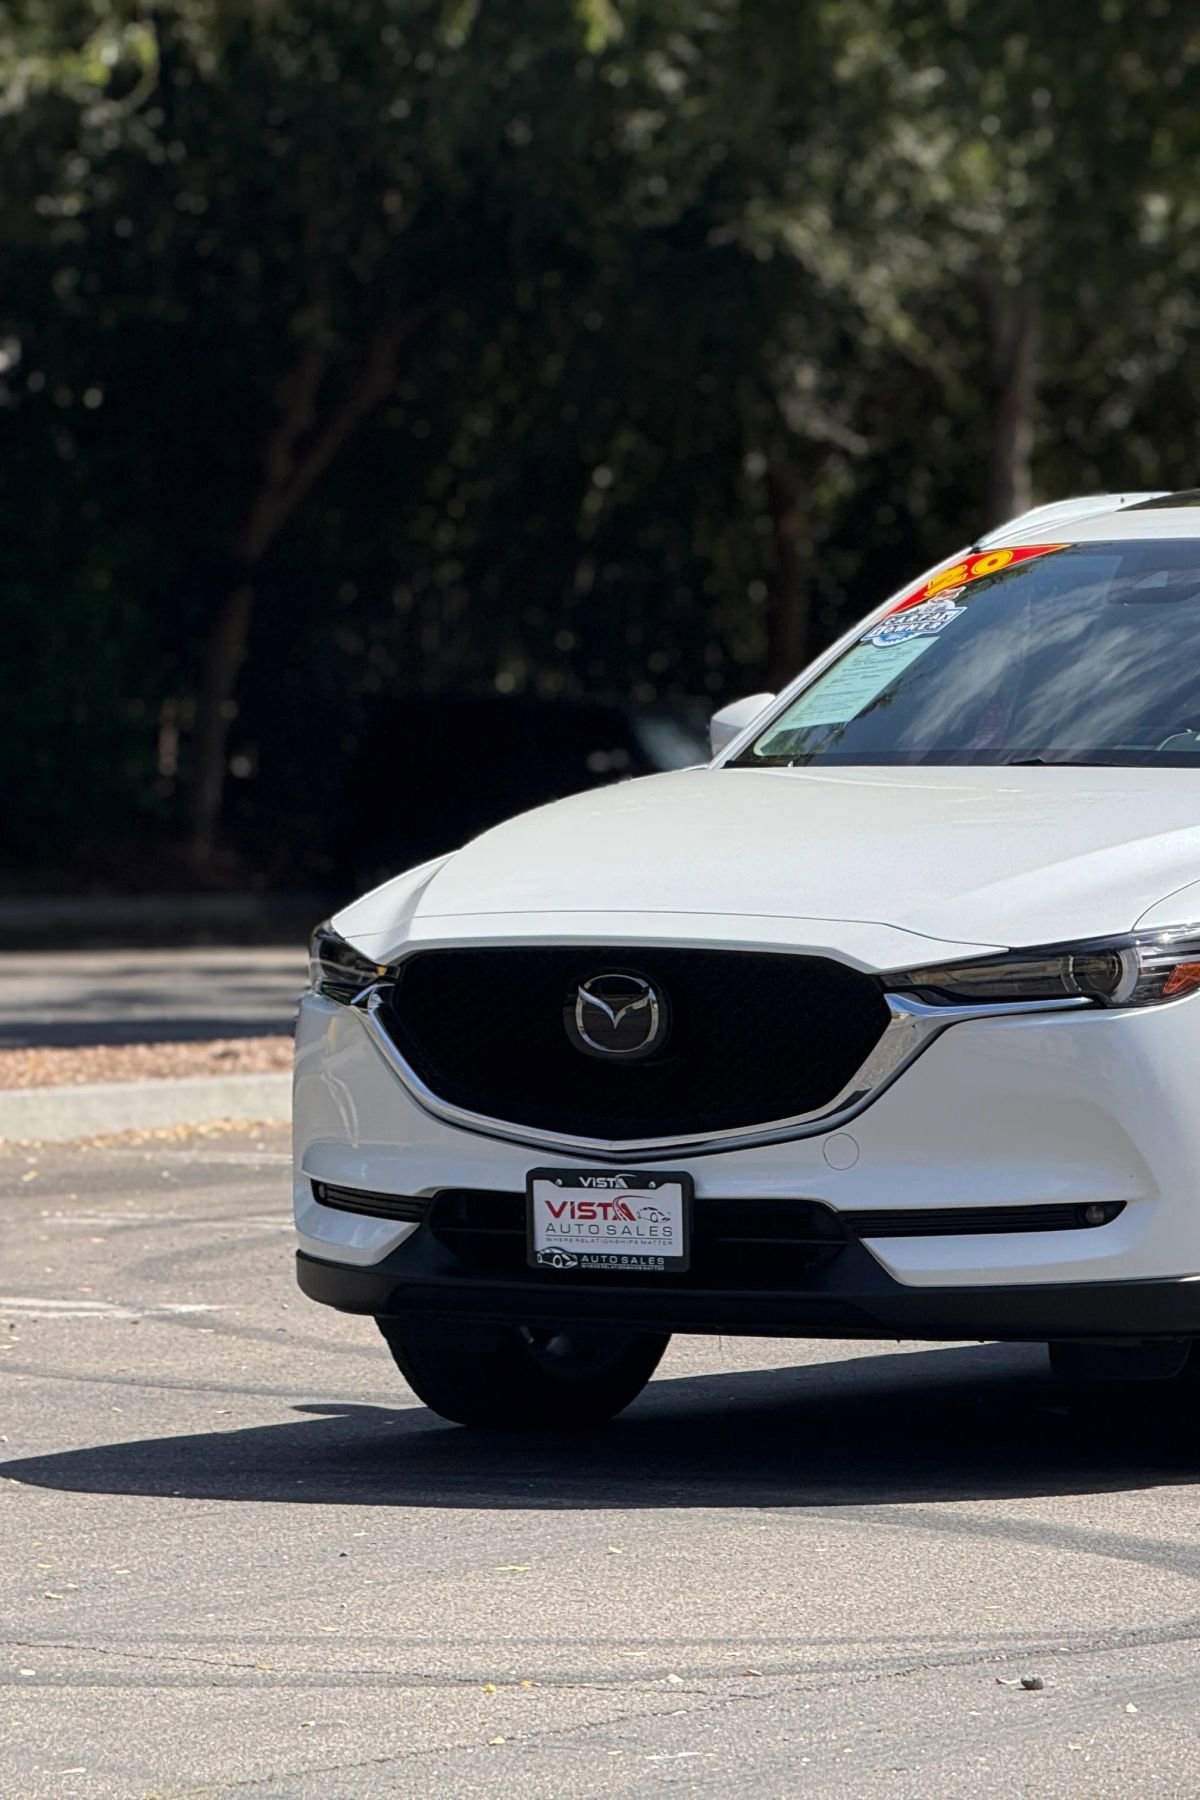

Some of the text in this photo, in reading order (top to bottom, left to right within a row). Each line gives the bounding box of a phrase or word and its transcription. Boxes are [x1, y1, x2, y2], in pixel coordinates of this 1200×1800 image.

[579, 1176, 628, 1188] VISTA
[544, 1200, 636, 1221] VISTA
[545, 1222, 673, 1237] AUTO SALES
[581, 1255, 665, 1265] AUTO SALES
